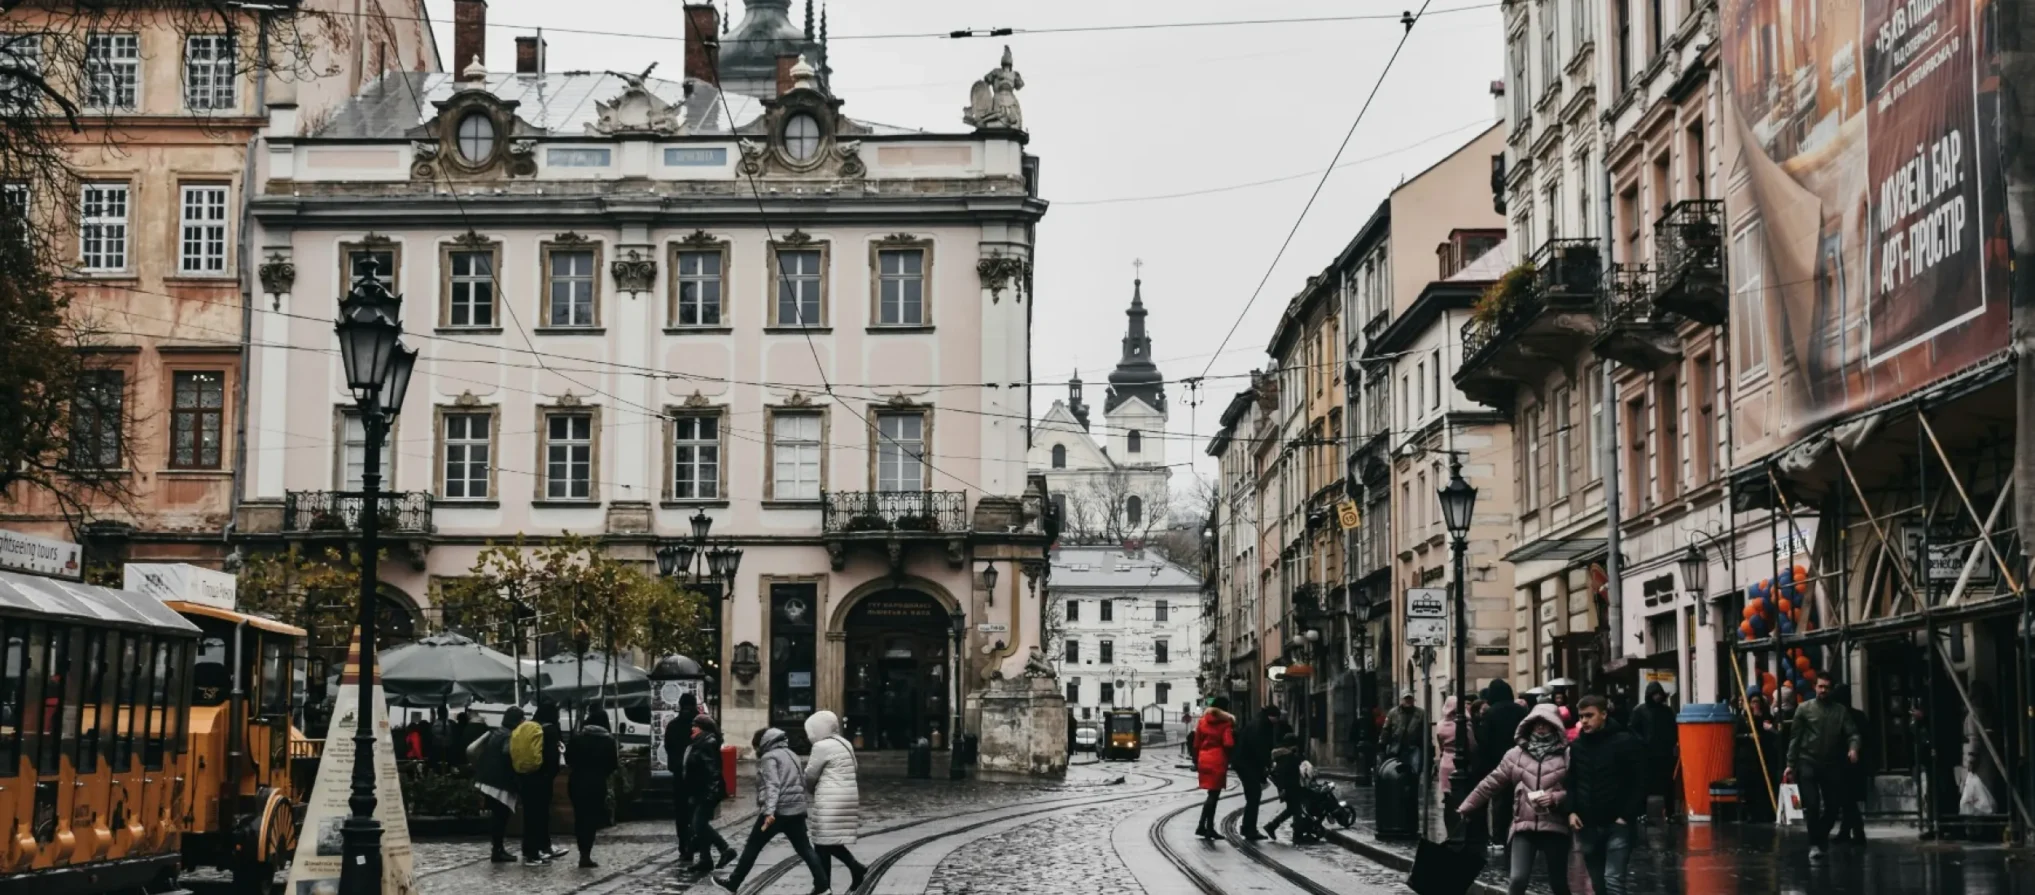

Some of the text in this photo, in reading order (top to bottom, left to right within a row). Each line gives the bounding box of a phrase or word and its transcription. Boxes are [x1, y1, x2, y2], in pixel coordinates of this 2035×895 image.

[1881, 129, 1964, 233] МУЗЕЙ. БАР.
[1881, 195, 1966, 295] АРТ-ПРОСТІР
[37, 543, 58, 560] tours
